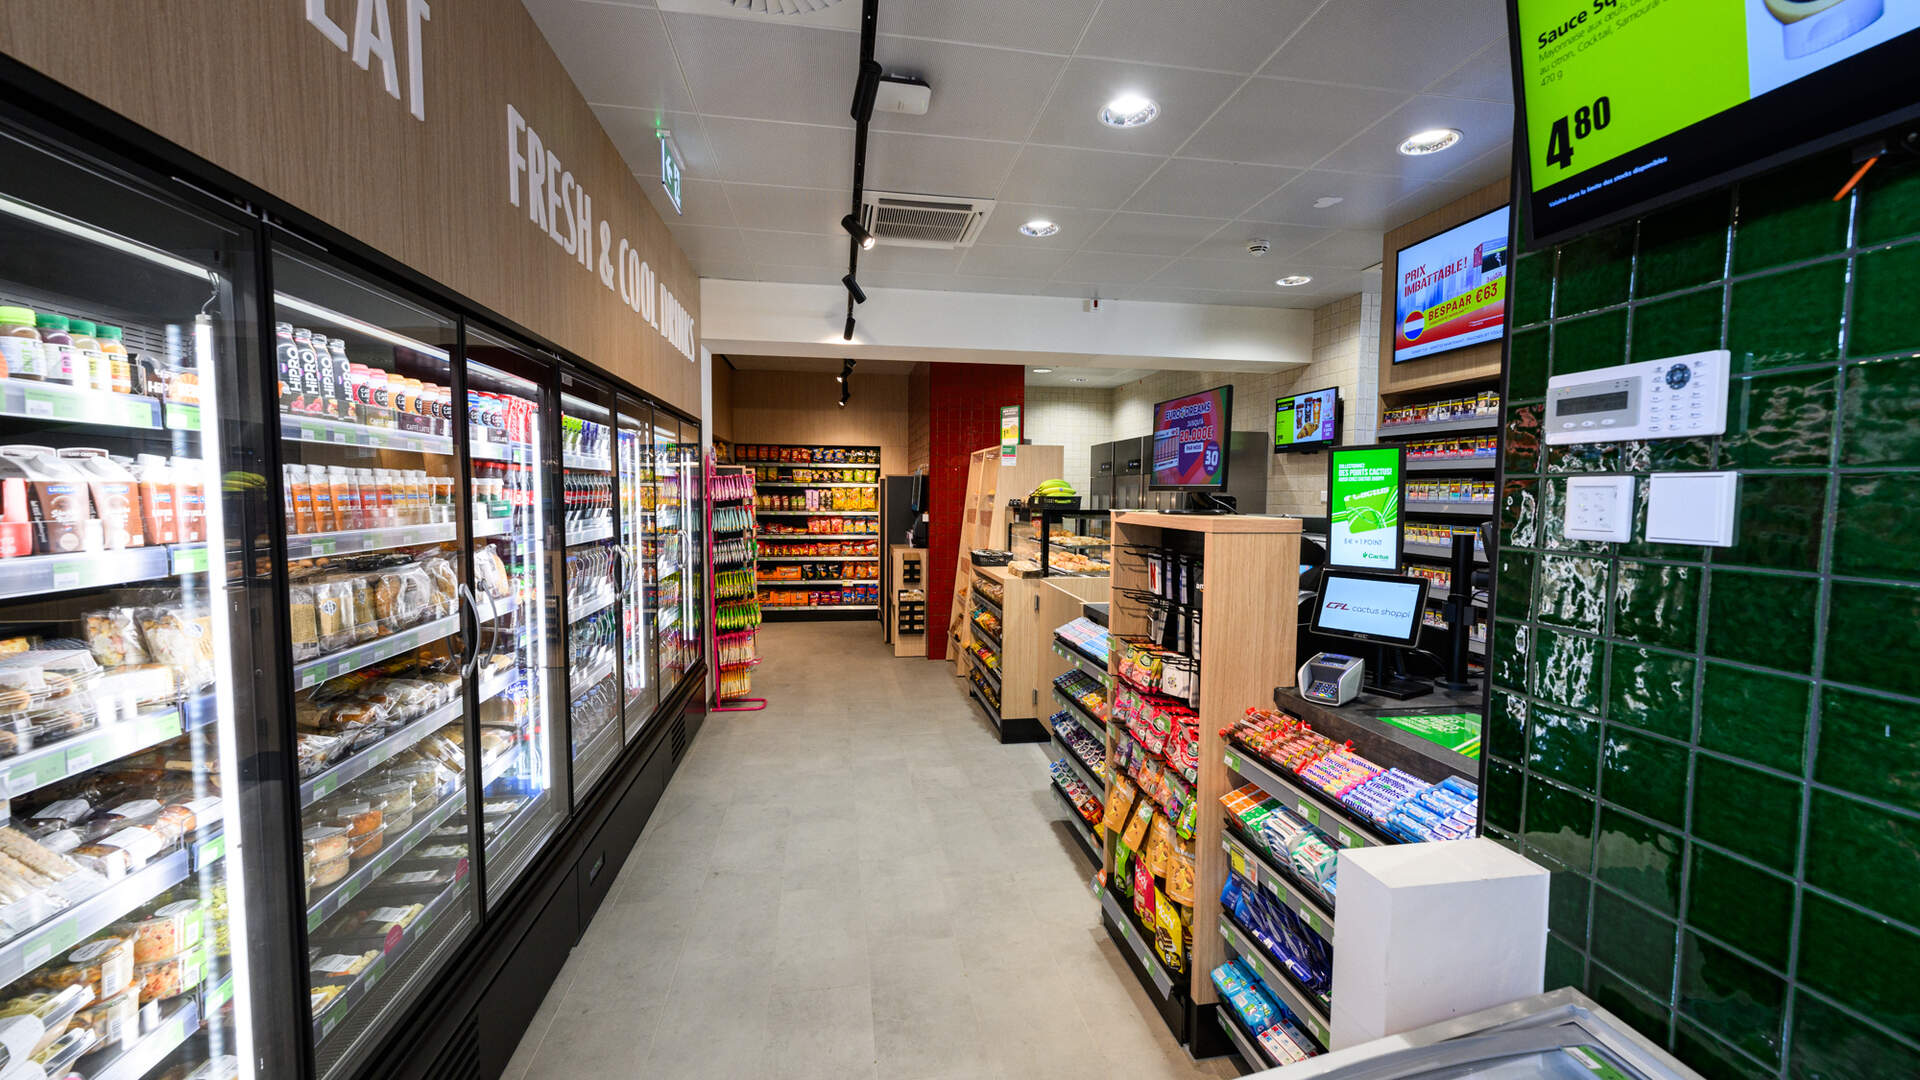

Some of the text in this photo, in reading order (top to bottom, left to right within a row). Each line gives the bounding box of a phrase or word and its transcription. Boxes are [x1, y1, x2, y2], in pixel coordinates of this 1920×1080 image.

[1537, 10, 1588, 50] Sauce
[1538, 29, 1586, 63] Mayonnaise
[306, 0, 431, 122] AT
[506, 103, 696, 363] FRESH & COOL DRINKS
[1404, 264, 1427, 285] PRIX
[1404, 256, 1468, 298] IMBATTABLE!
[1428, 294, 1472, 322] BESPAAR
[1475, 281, 1498, 303] €63
[1205, 449, 1219, 466] 30
[1149, 562, 1157, 589] N
[1326, 601, 1411, 618] CFL cactus shoppi
[1344, 798, 1374, 818] mentos
